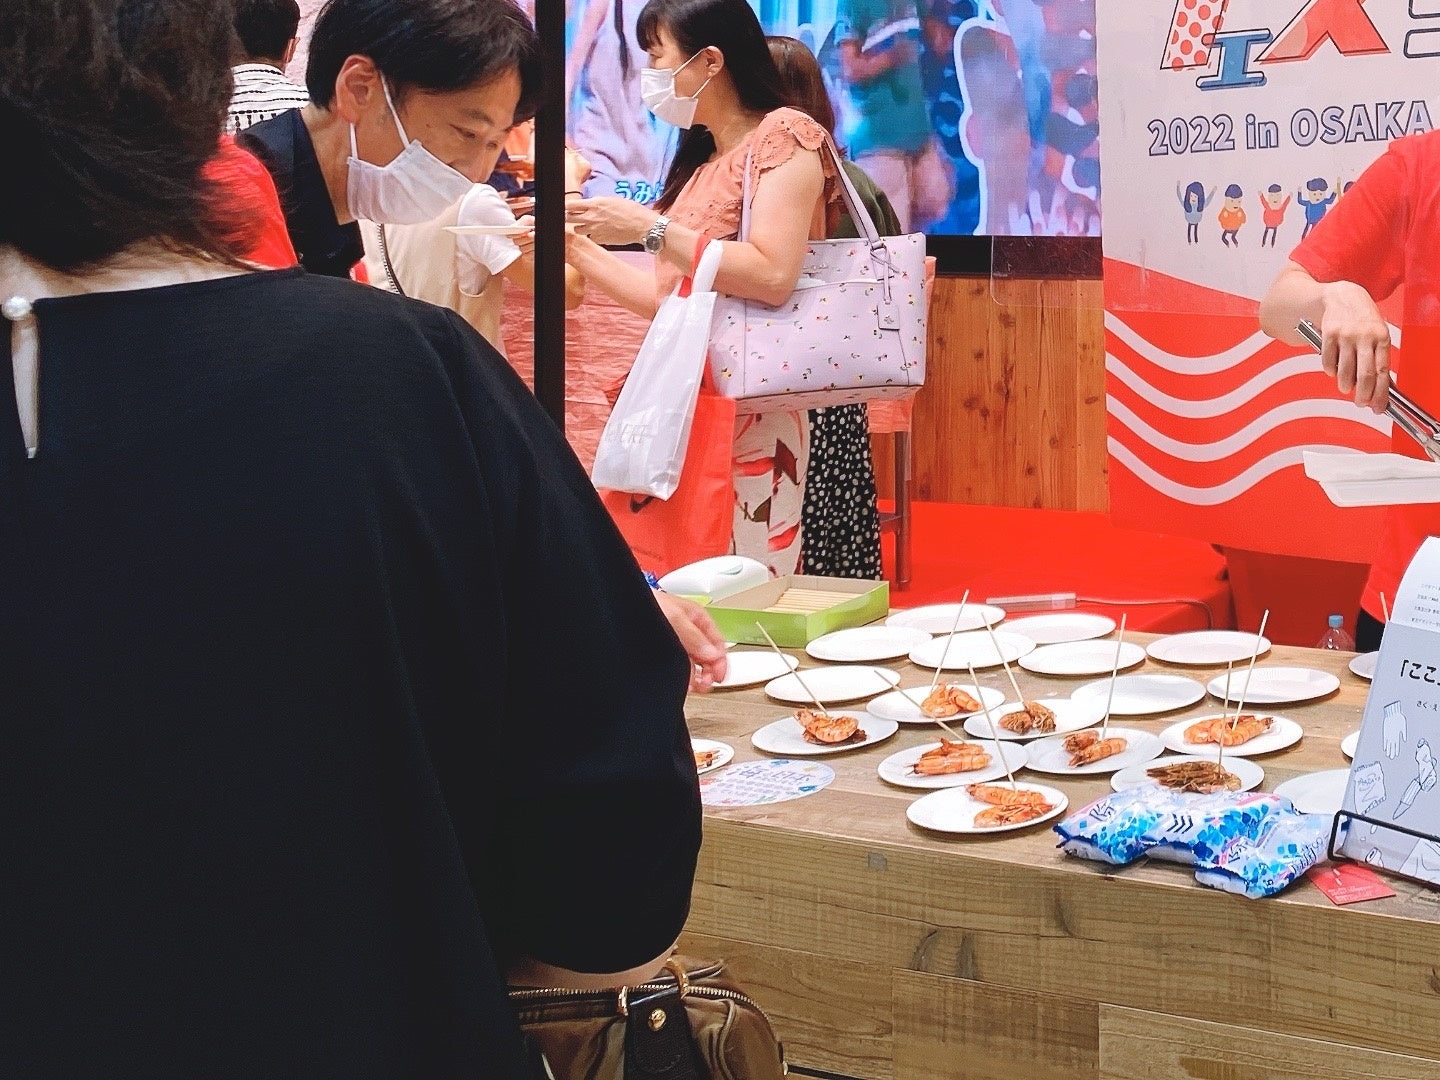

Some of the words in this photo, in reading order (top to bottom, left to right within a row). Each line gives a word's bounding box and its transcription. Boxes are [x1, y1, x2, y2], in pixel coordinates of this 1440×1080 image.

[1148, 114, 1235, 156] 2022
[1245, 114, 1279, 149] in
[1290, 100, 1434, 147] OSAKA
